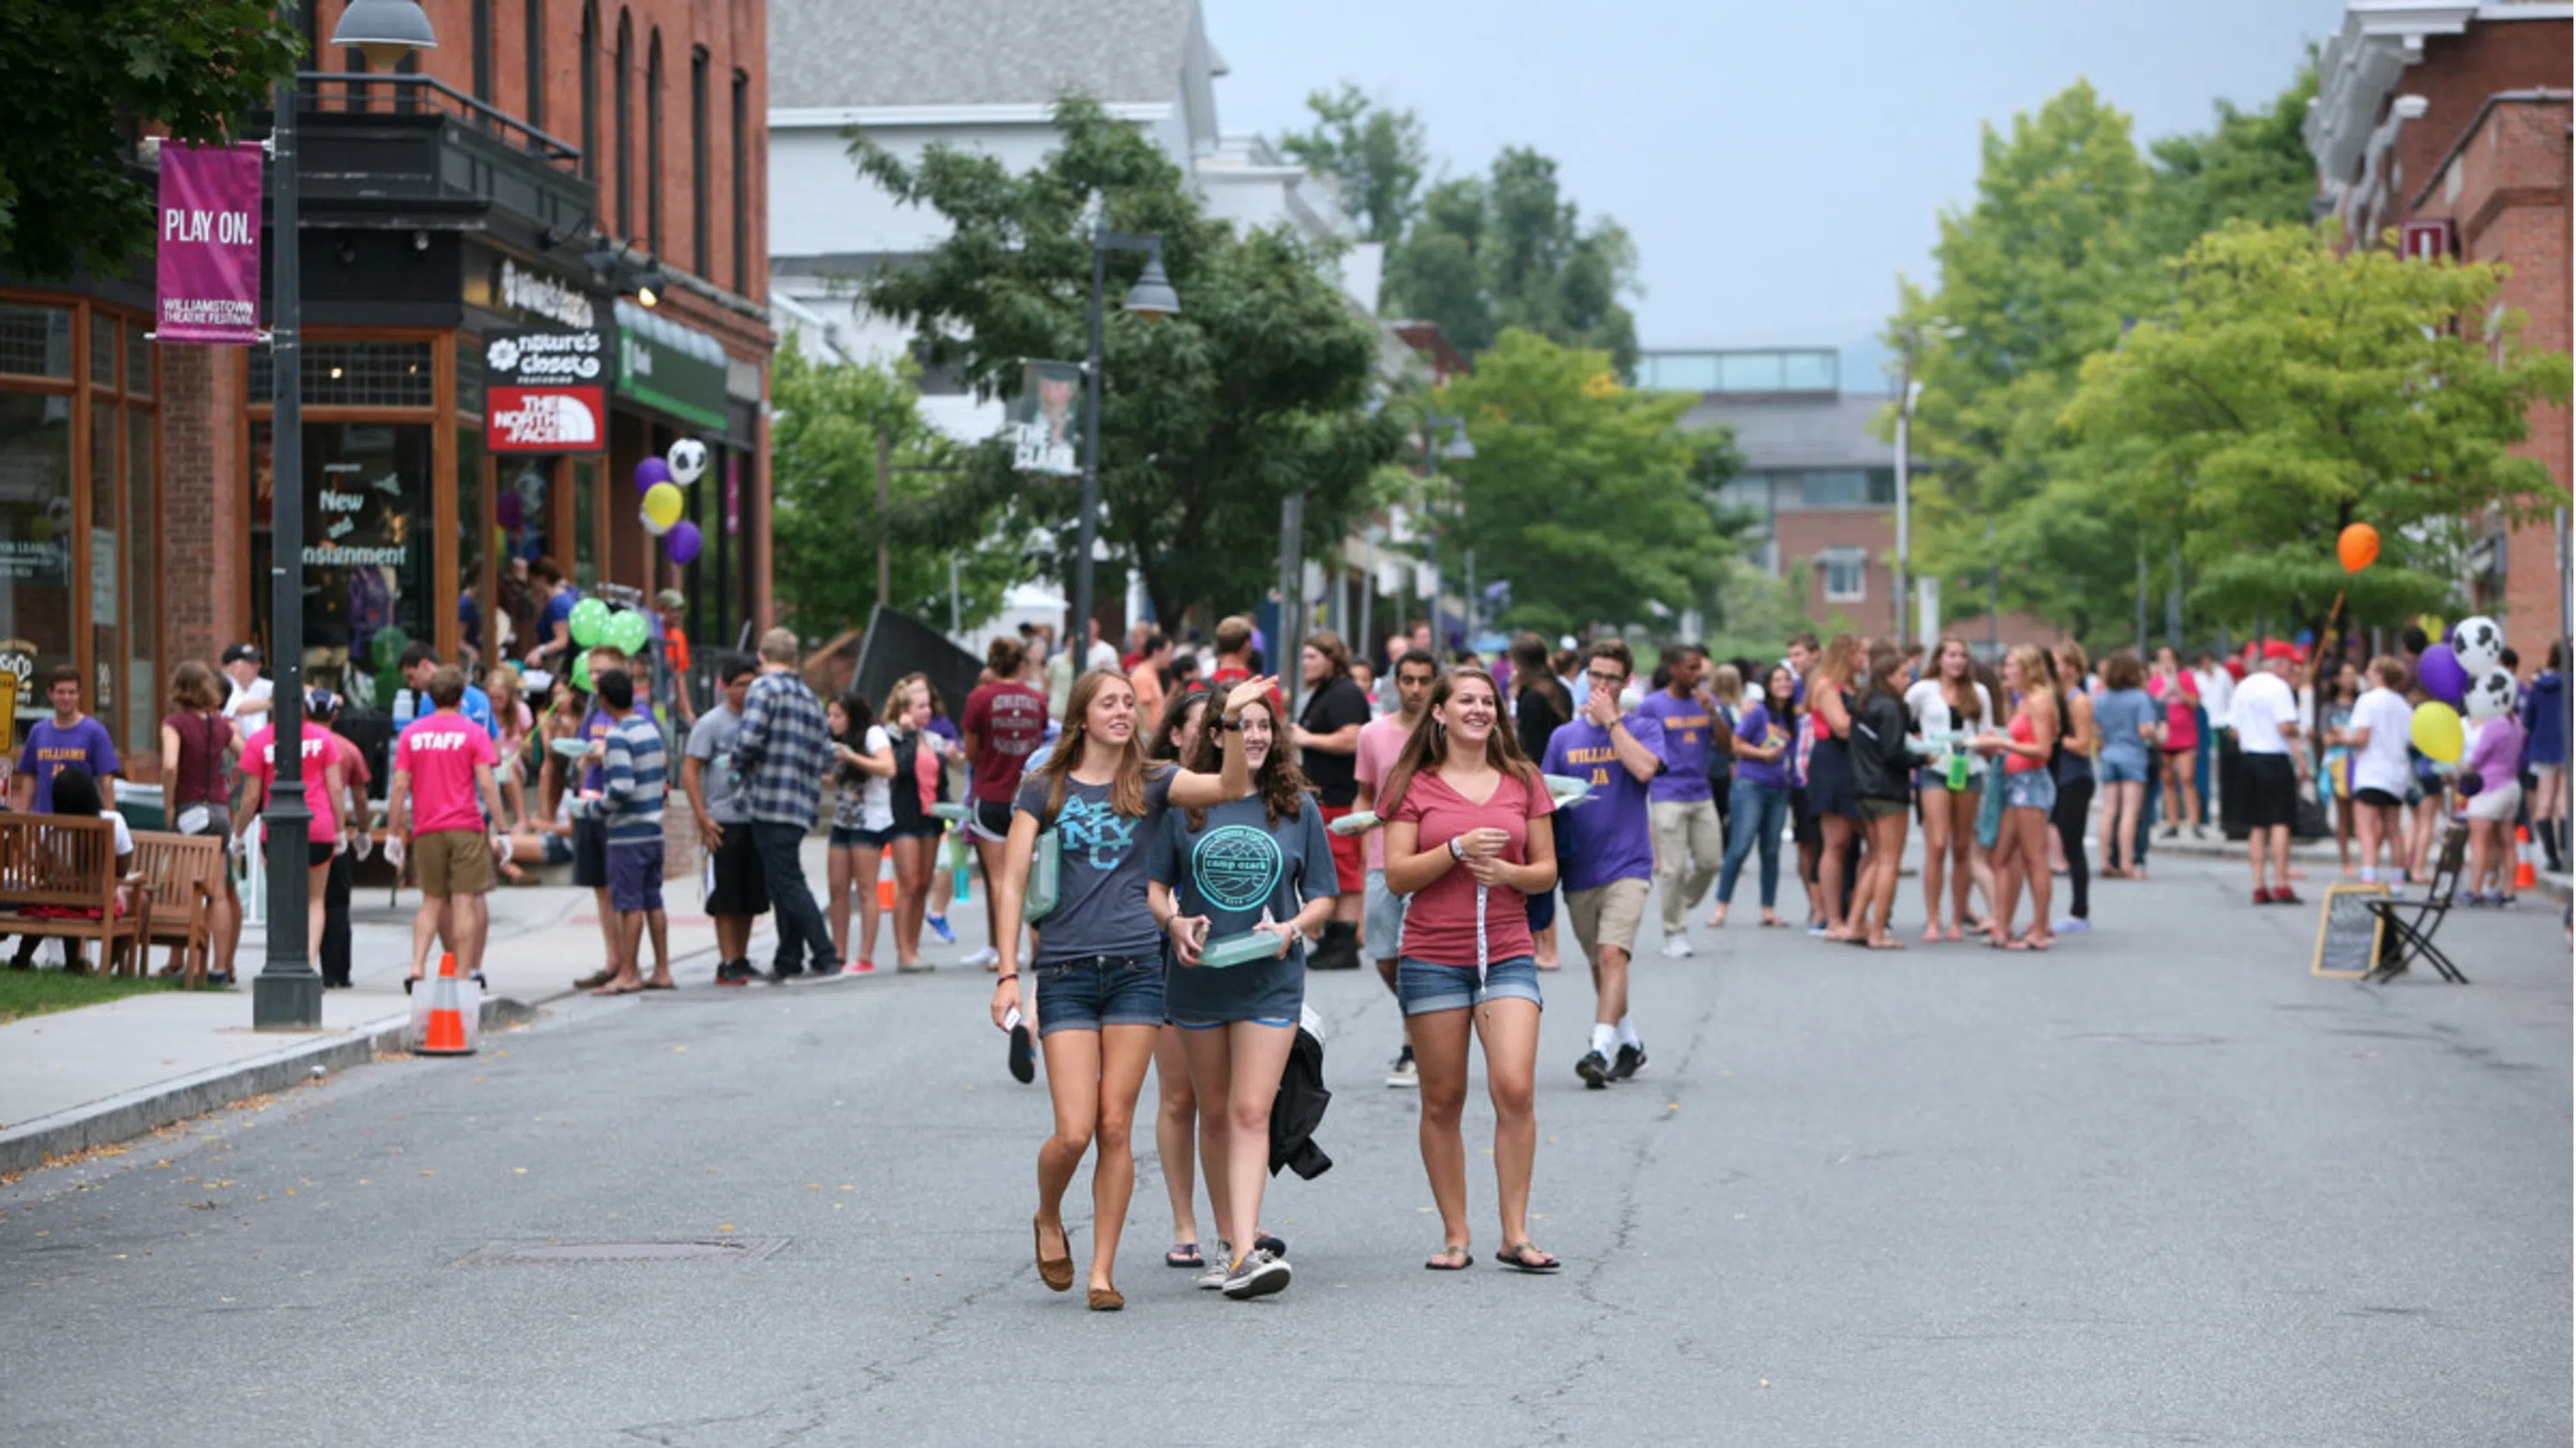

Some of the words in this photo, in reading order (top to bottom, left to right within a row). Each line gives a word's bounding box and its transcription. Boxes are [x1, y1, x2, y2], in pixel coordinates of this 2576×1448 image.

[166, 209, 213, 242] PLAY
[219, 211, 253, 245] ON.
[162, 298, 253, 313] WILLIAMSTOWN
[164, 309, 206, 324] THEATRE
[207, 312, 254, 325] FESTIVAL
[518, 331, 601, 353] nature's
[520, 352, 601, 378] closet
[520, 395, 558, 412] THE
[494, 411, 558, 429] NORTH
[510, 427, 558, 443] FACE
[319, 488, 365, 513] New
[301, 546, 406, 566] nsignment
[410, 732, 466, 751] STAFF
[264, 739, 323, 764] SFF
[1567, 746, 1620, 764] WILLIA
[1590, 767, 1611, 785] JA
